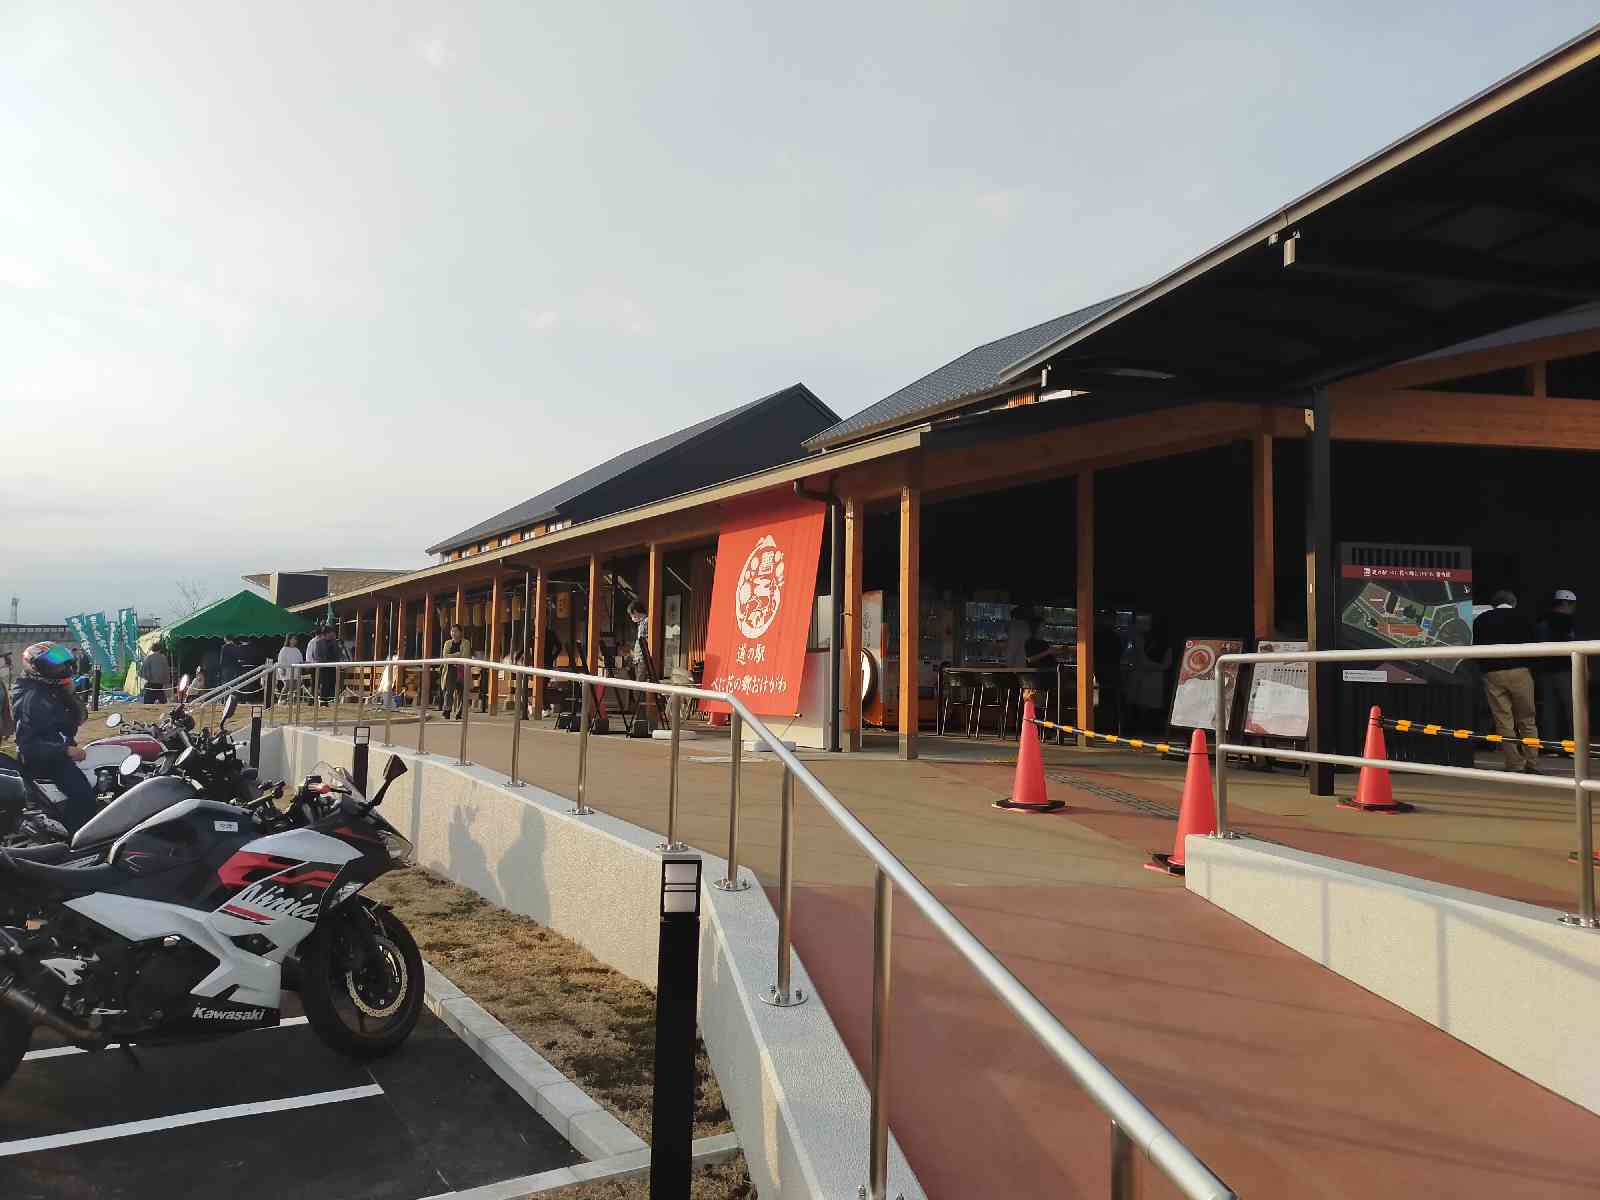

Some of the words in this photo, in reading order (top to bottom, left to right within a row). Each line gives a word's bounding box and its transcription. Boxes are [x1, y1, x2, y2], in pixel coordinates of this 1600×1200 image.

[736, 642, 766, 666] 道の駅
[240, 884, 320, 921] Ninja
[191, 1006, 266, 1021] Kawasaki
